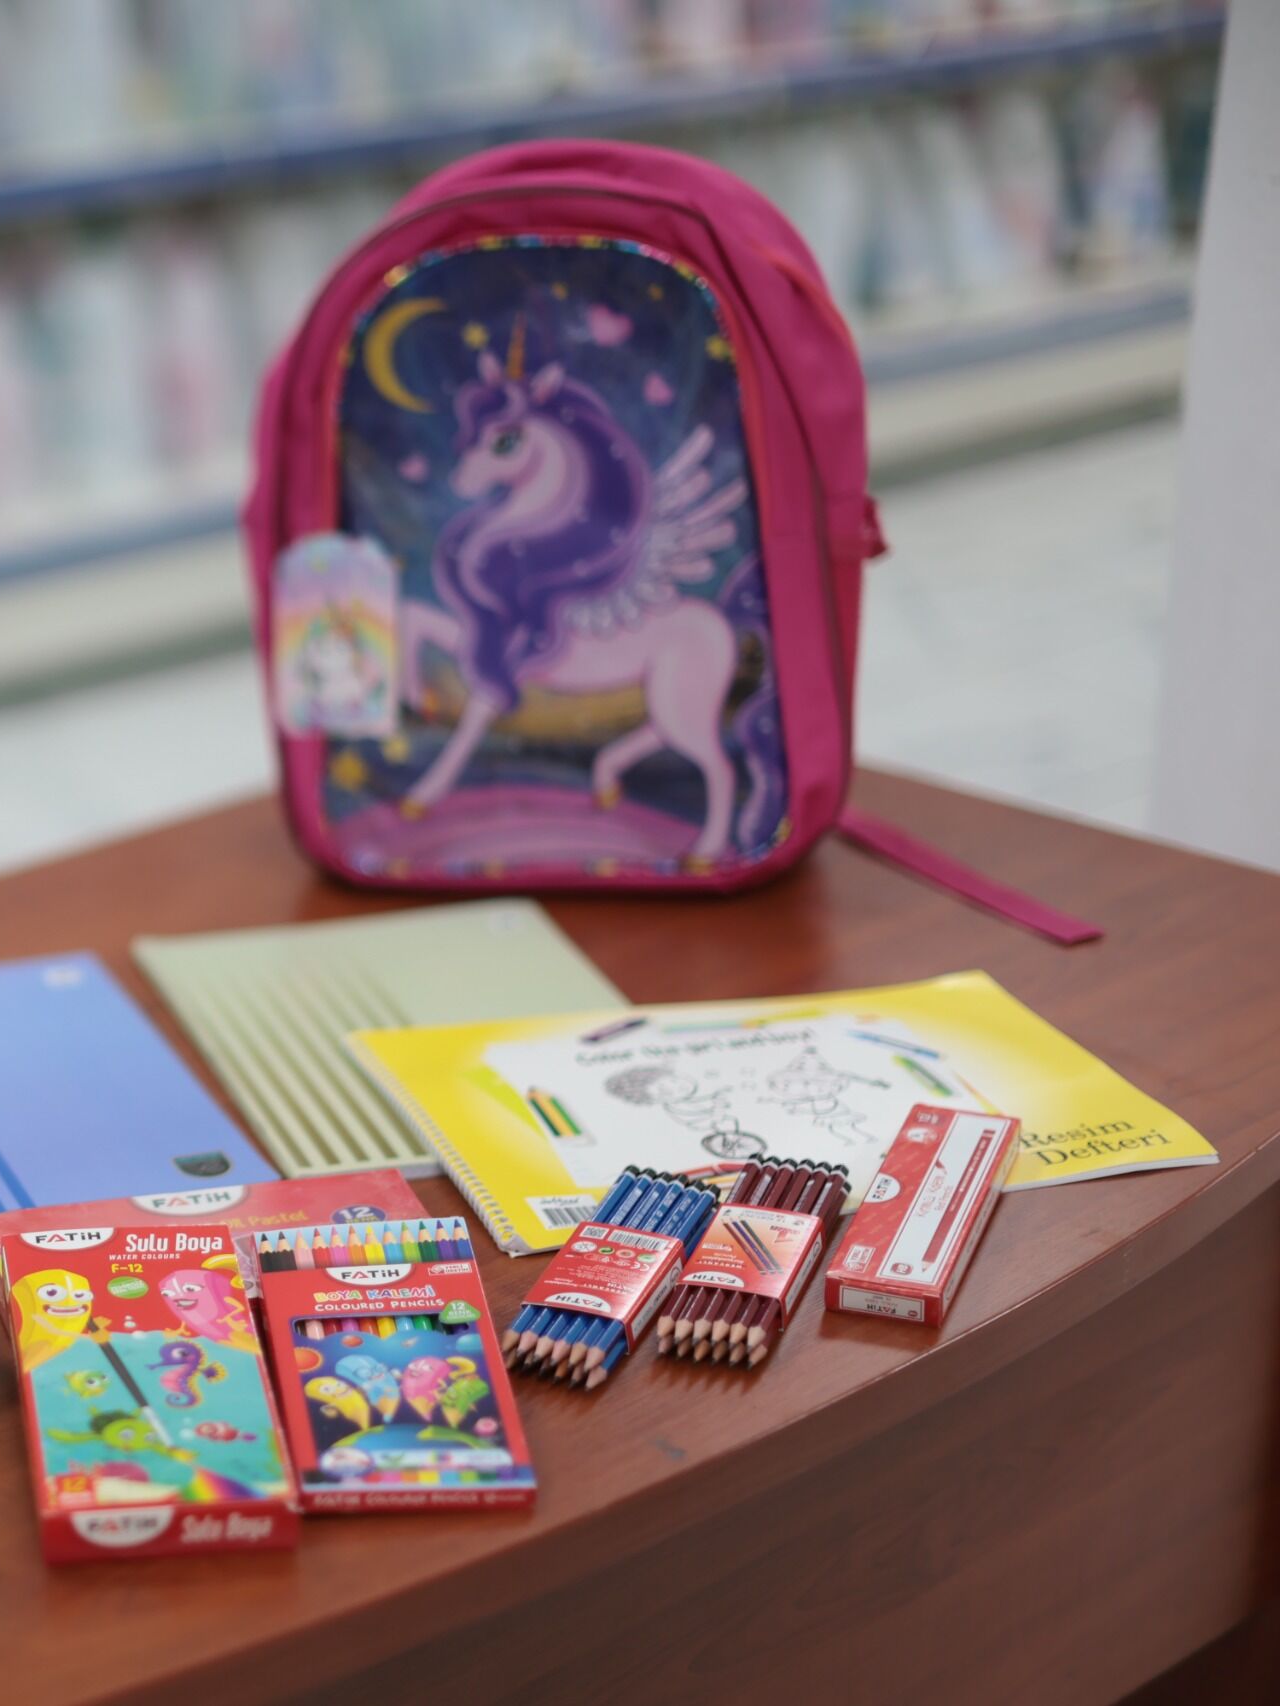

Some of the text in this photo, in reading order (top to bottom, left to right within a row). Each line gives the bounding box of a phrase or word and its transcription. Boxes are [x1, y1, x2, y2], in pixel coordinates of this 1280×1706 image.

[1019, 1120, 1135, 1149] Resim
[1034, 1129, 1172, 1165] Defteri
[152, 1191, 231, 1208] FATiH
[251, 1210, 309, 1227] Pastel
[339, 1206, 374, 1220] 12
[35, 1232, 223, 1254] FATiH Sulu Boya
[111, 1264, 144, 1273] F-12
[341, 1269, 400, 1280] FATiH
[313, 1290, 362, 1302] BOYA
[314, 1299, 445, 1312] COLOURED PENCILS
[450, 1302, 465, 1310] 12
